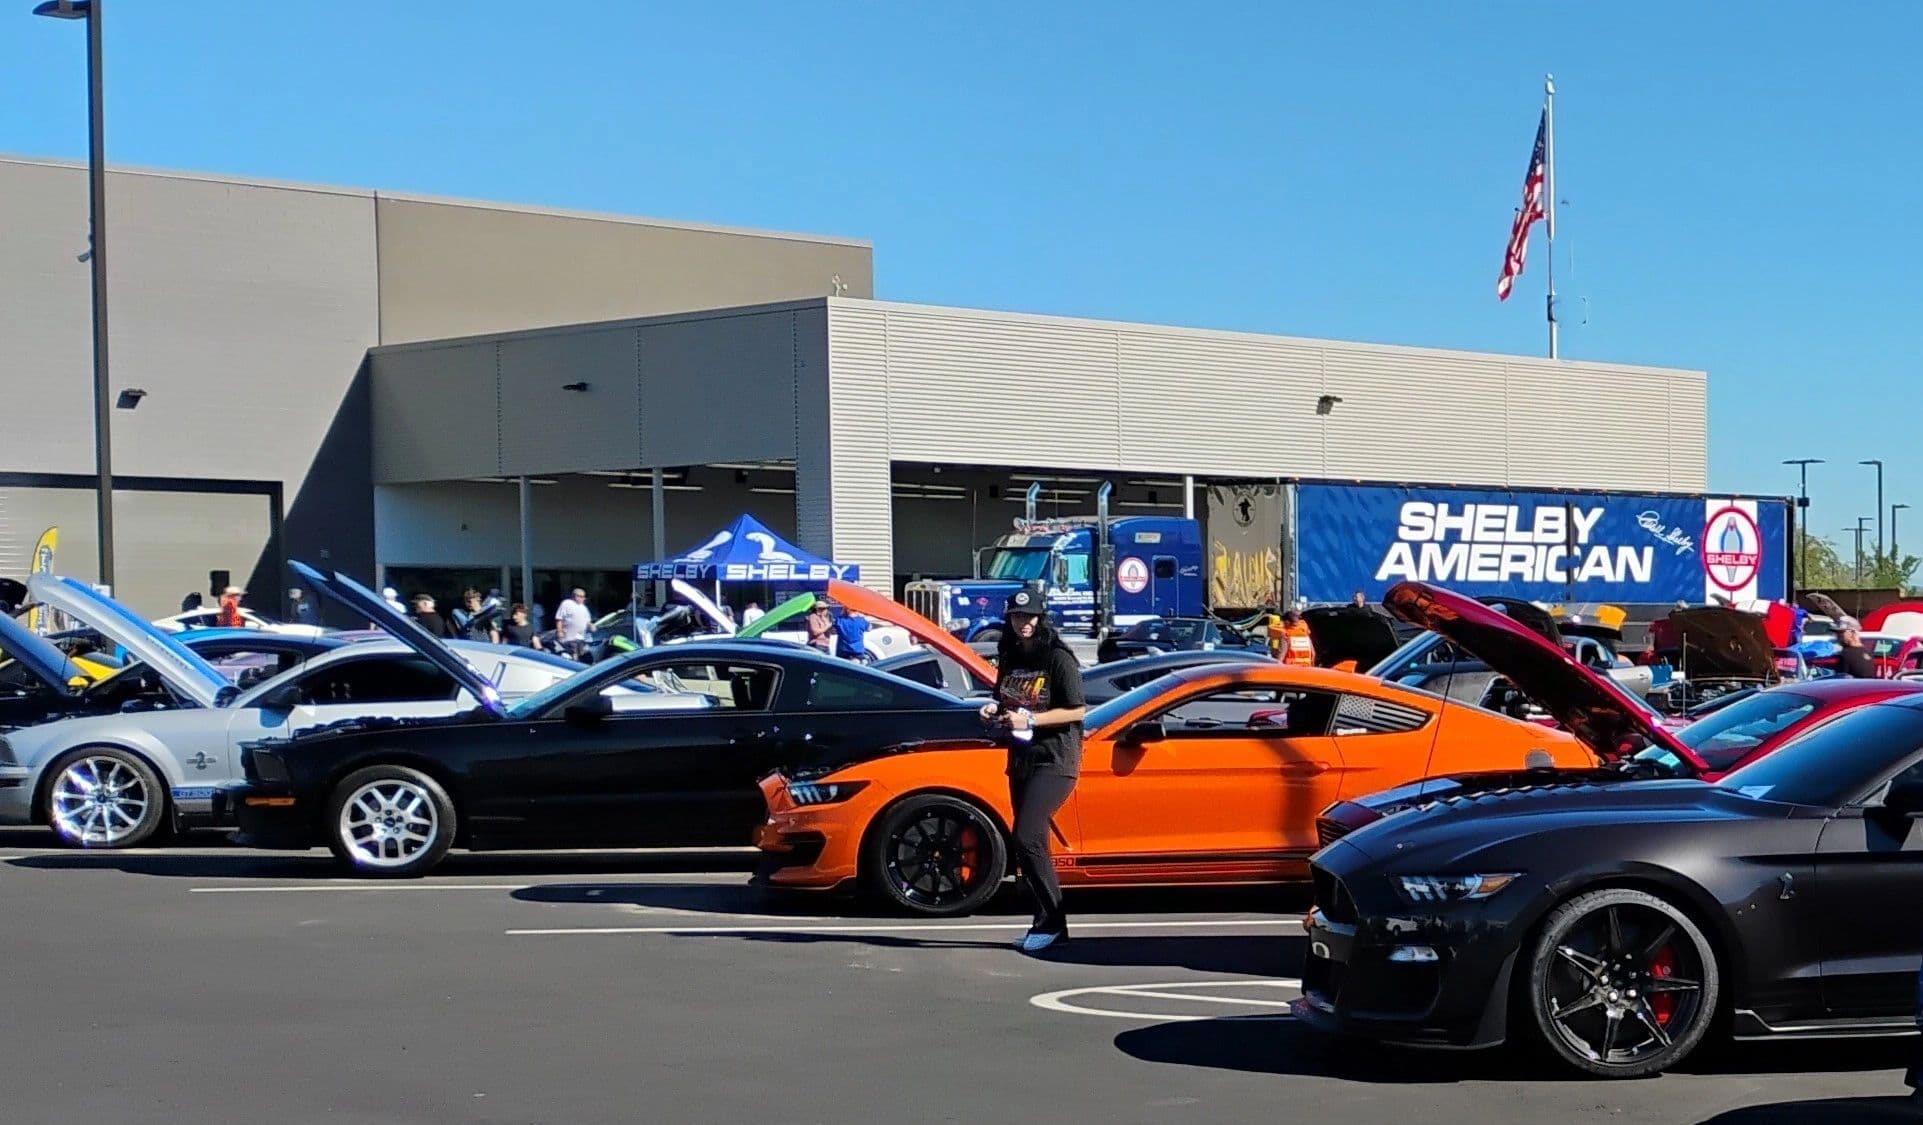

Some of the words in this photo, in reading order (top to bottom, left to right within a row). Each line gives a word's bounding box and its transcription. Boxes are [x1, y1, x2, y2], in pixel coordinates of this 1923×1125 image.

[1398, 501, 1604, 545] SHELBY
[1375, 541, 1654, 583] AMERICAN
[1706, 553, 1758, 565] SHELBY
[637, 564, 710, 580] SHELBY
[726, 563, 850, 580] SHELBY
